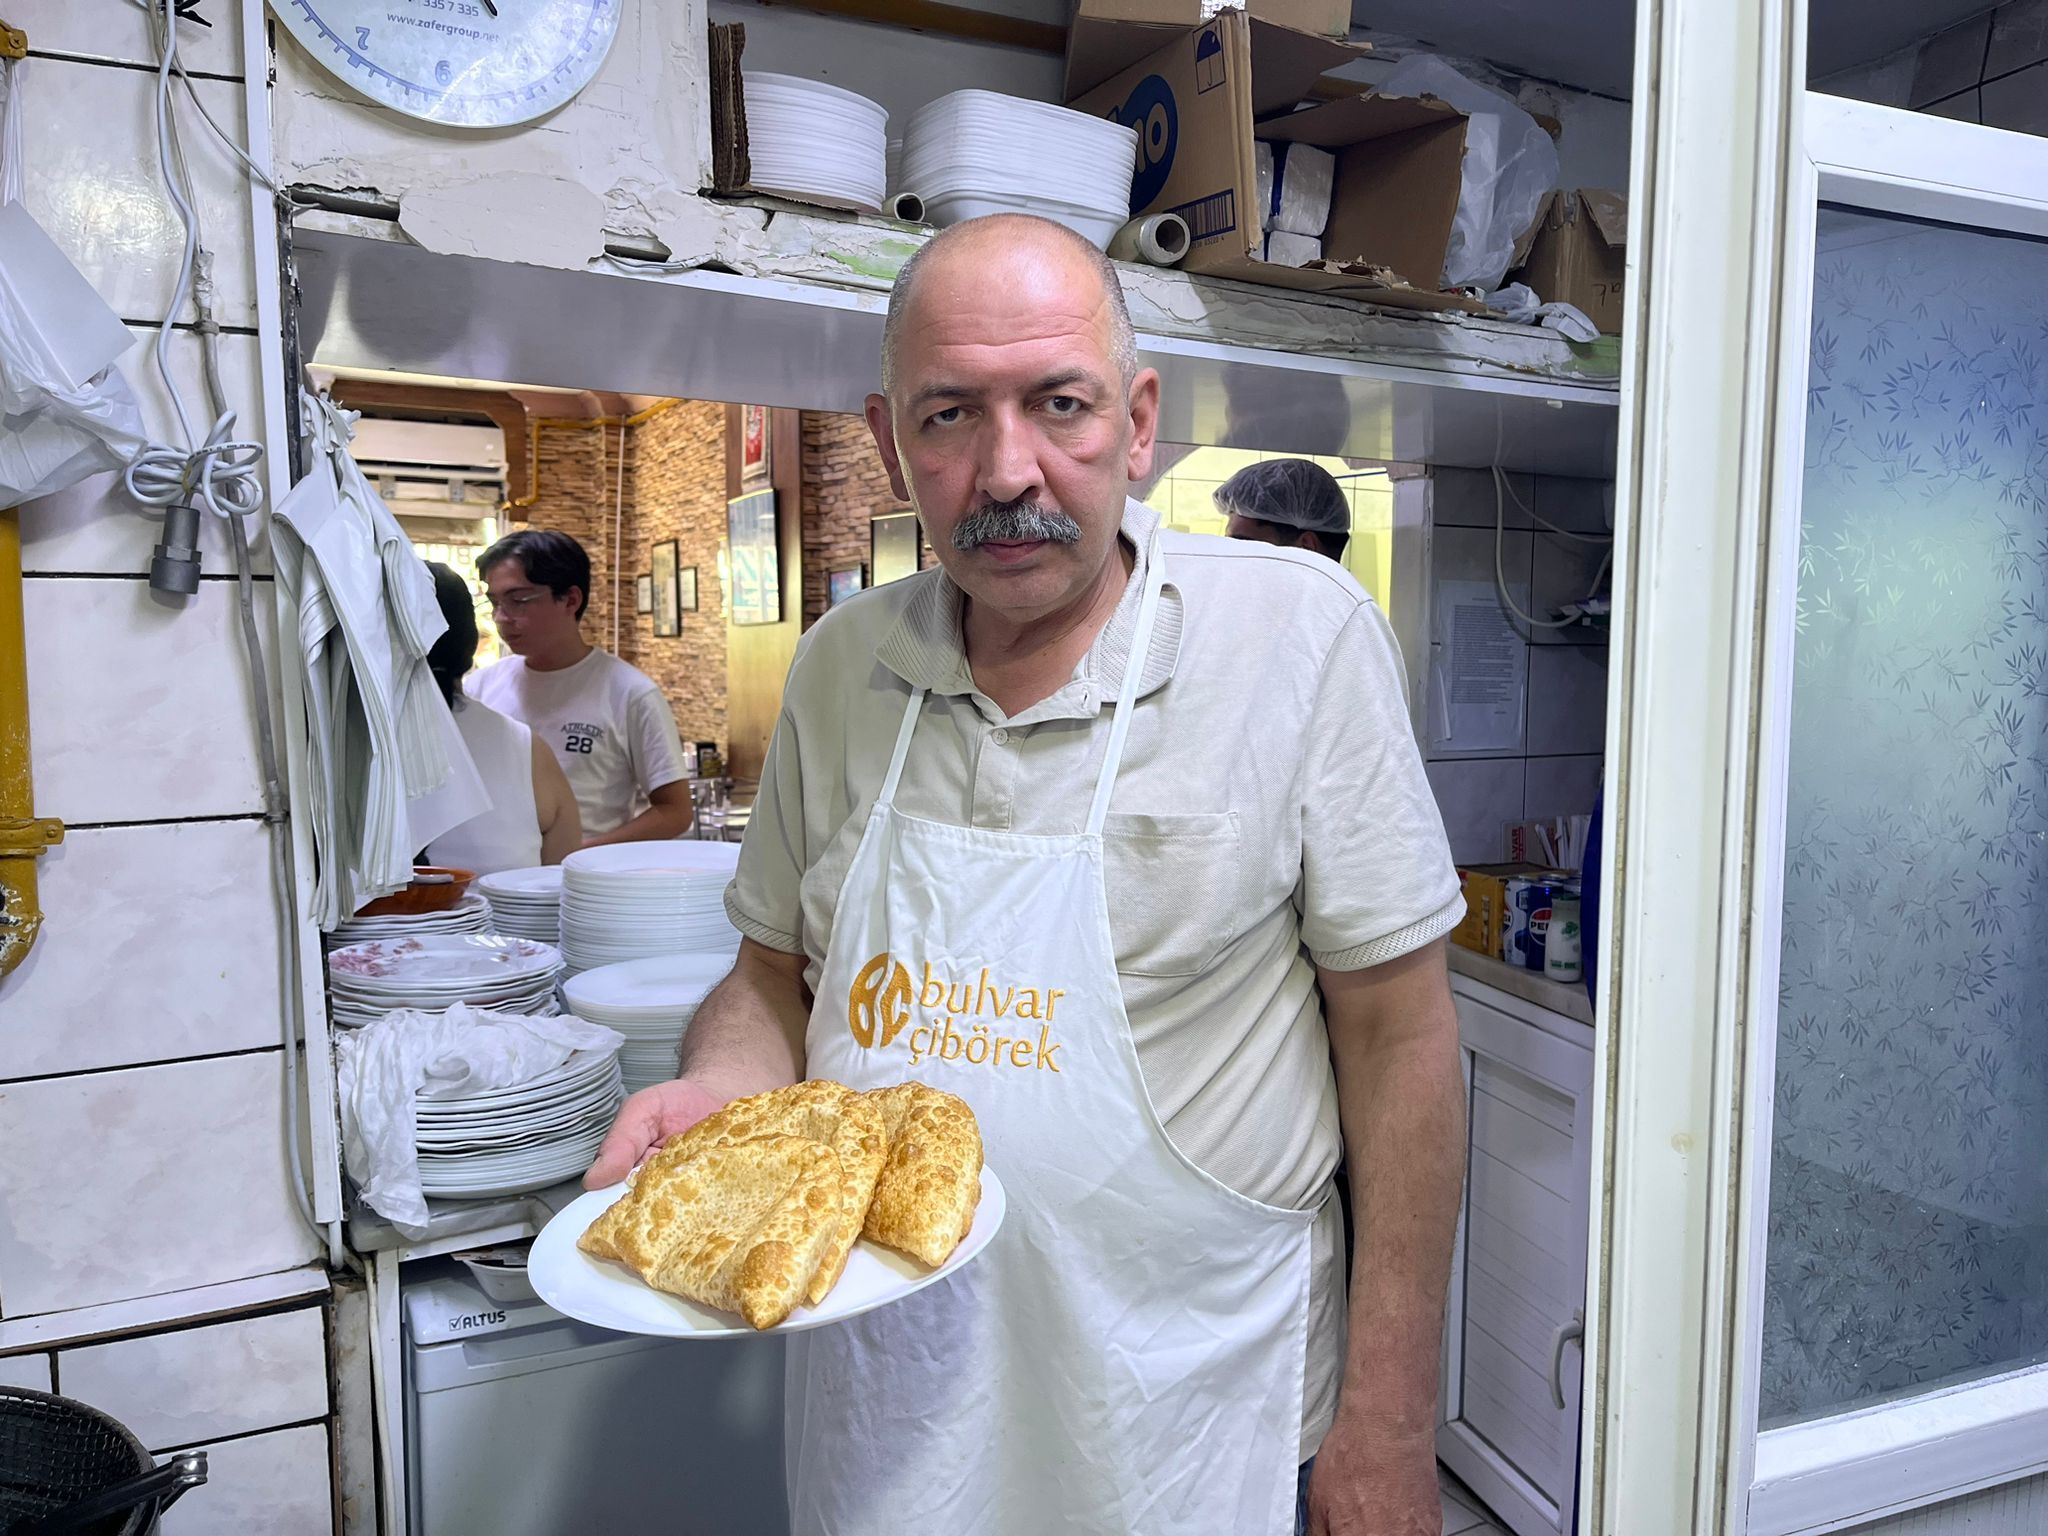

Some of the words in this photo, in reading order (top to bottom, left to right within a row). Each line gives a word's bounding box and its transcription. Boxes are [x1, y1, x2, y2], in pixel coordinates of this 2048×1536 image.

[447, 1, 455, 12] 7
[457, 3, 479, 17] 335
[355, 26, 371, 51] 7
[434, 60, 453, 87] 6
[565, 735, 593, 754] 28
[918, 959, 1066, 1021] bulvar
[907, 1016, 1061, 1073] çibörek
[462, 1310, 507, 1329] ALTUS
